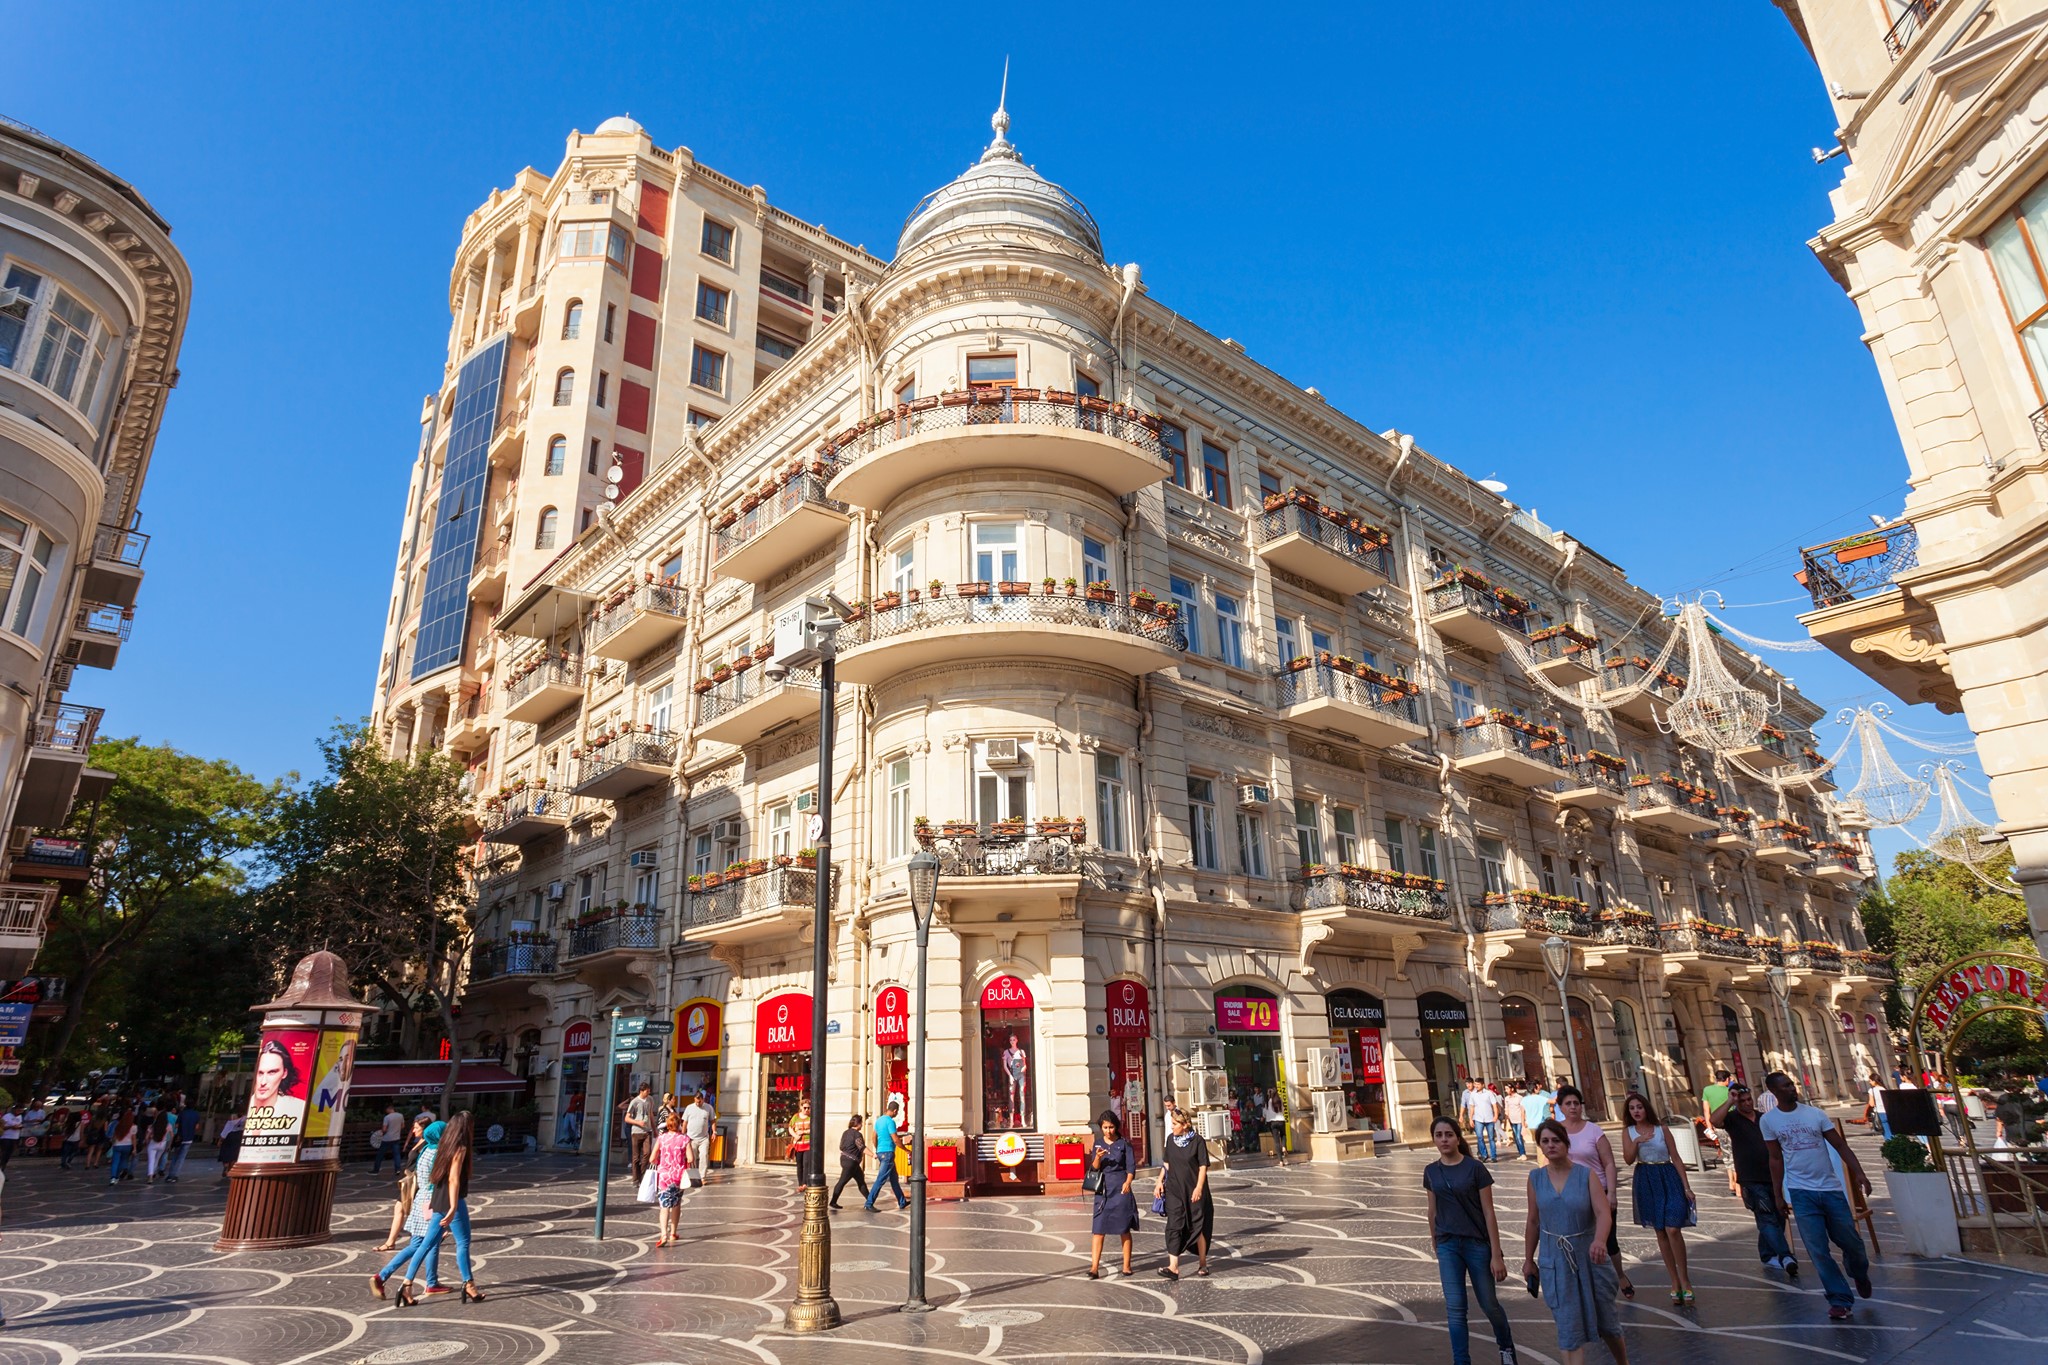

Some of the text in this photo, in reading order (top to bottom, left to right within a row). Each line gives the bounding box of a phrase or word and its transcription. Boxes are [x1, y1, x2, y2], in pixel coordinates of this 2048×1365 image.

[987, 988, 1025, 1001] BURLA
[1113, 1007, 1147, 1026] BURLA
[1246, 1002, 1271, 1027] 70
[877, 1014, 904, 1035] BURLA
[568, 1031, 590, 1047] ALGO
[768, 1025, 796, 1043] BURLA
[1367, 1065, 1380, 1073] SALE
[775, 1075, 805, 1091] SALE
[888, 1081, 907, 1093] SALE
[268, 1136, 278, 1145] 35
[279, 1135, 290, 1144] 40
[998, 1147, 1025, 1156] Shaurma
